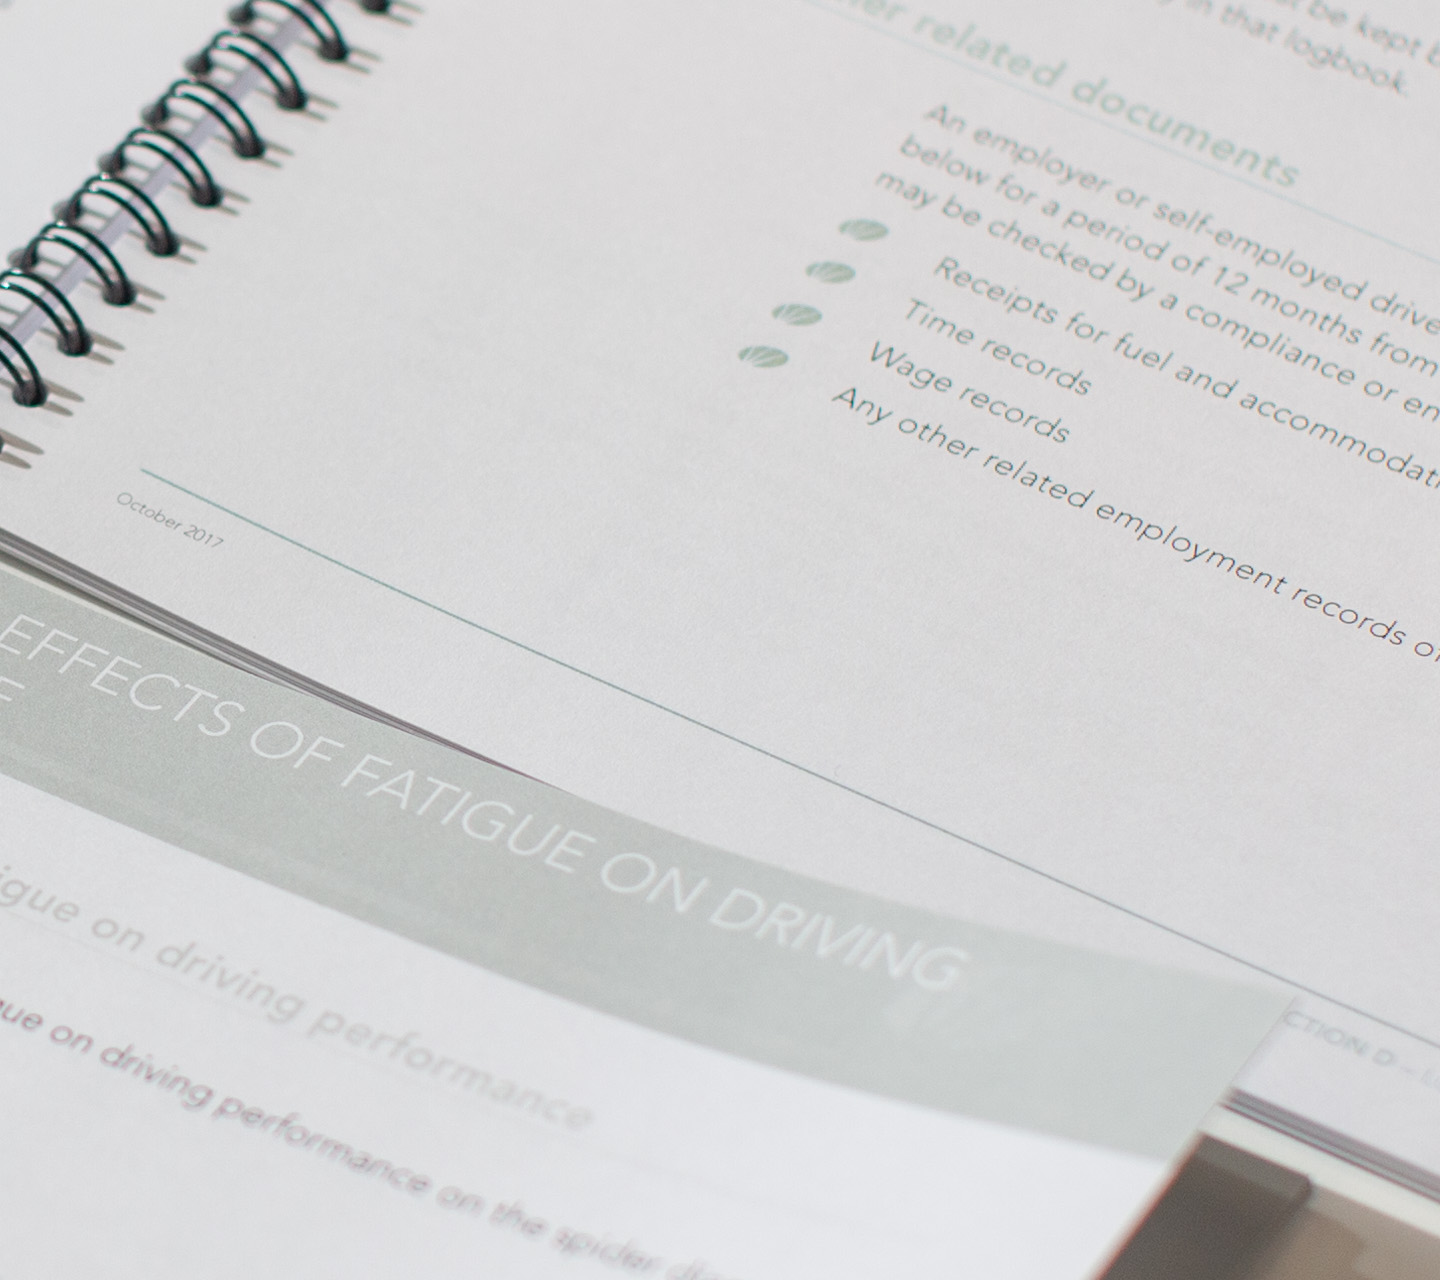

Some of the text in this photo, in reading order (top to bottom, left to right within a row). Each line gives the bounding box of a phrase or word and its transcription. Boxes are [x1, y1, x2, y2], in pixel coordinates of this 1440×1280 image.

[913, 14, 1070, 89] related
[1071, 76, 1301, 188] documents
[870, 340, 1071, 444] Wage records
[905, 297, 1093, 397] Time records
[933, 255, 1059, 325] Receipts
[1064, 310, 1110, 344] for
[1112, 331, 1175, 372] fuel
[1174, 365, 1240, 400] and
[116, 491, 225, 549] October 2017
[831, 386, 894, 427] Any
[897, 417, 980, 460] other
[982, 454, 1096, 510] related
[1095, 503, 1289, 595] employment
[1290, 587, 1408, 647] records
[249, 719, 347, 770] OF
[339, 752, 598, 874] FATIGUE
[599, 851, 711, 915] ON
[707, 886, 970, 992] DRIVING
[90, 917, 148, 953] on
[154, 941, 308, 1027] driving
[303, 1009, 594, 1132] performance
[48, 1024, 95, 1055] on
[98, 1043, 216, 1112] driving
[210, 1096, 433, 1197] performance
[435, 1185, 486, 1217] on
[489, 1202, 550, 1240] the
[552, 1227, 661, 1275] spider
